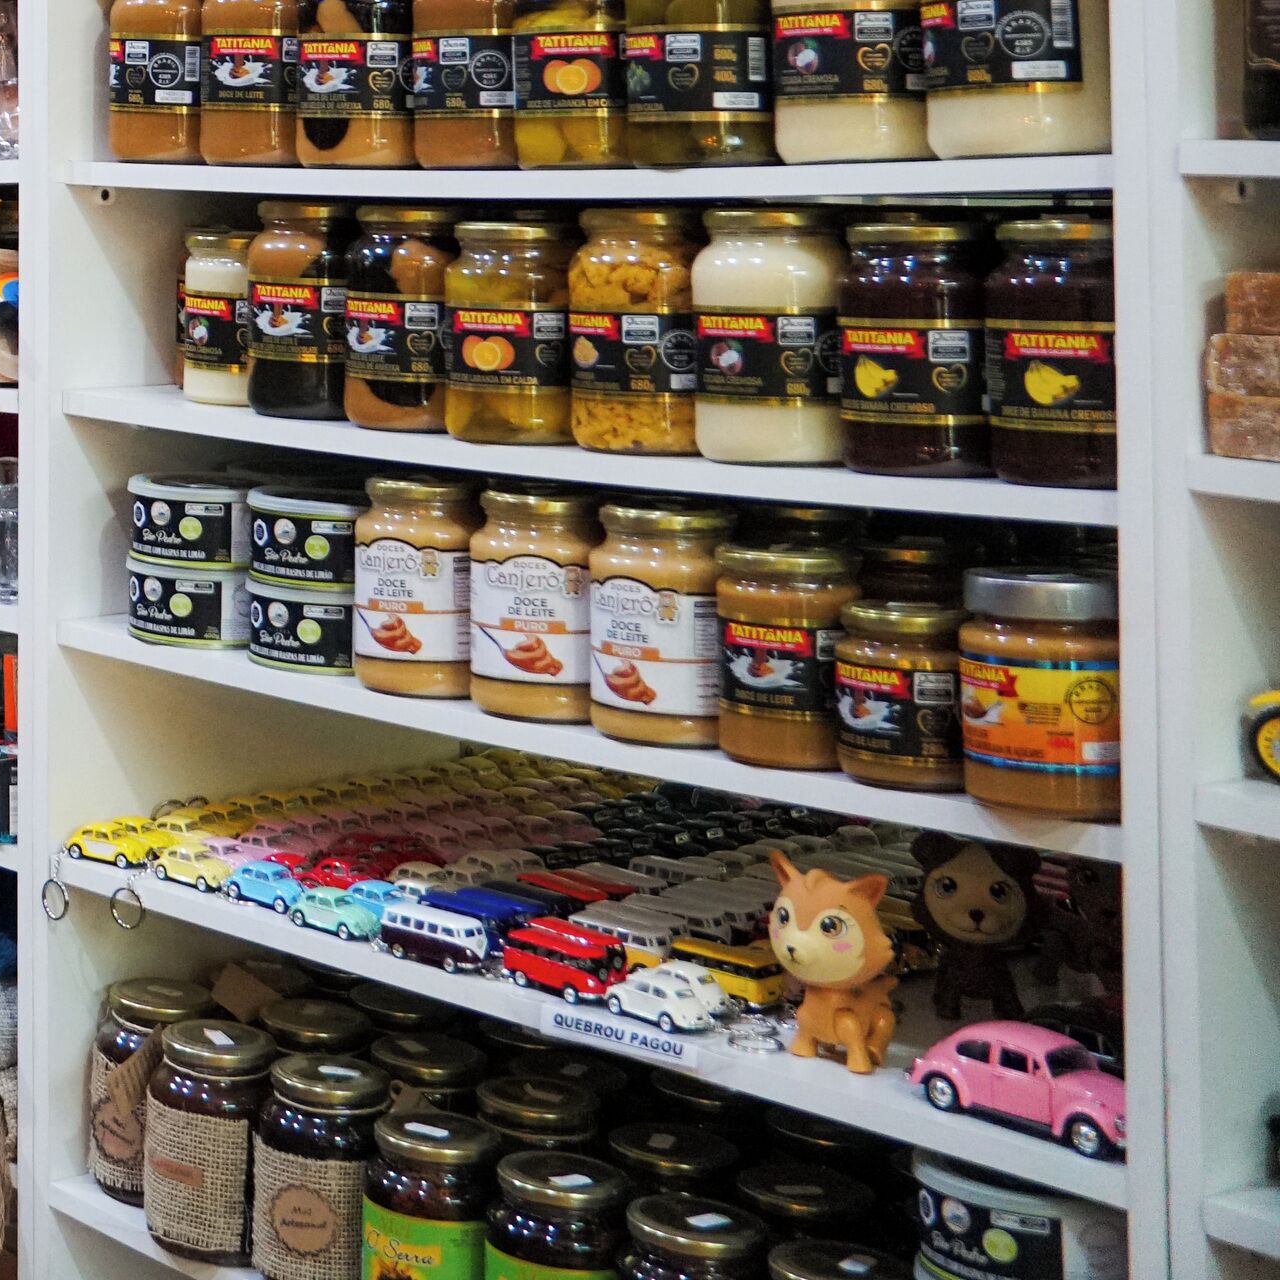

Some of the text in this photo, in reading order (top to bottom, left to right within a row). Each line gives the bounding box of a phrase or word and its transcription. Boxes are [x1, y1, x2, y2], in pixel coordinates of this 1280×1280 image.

[376, 544, 406, 553] DOCES
[513, 560, 547, 570] DOCES
[315, 569, 333, 580] LIMÃO
[488, 566, 559, 591] Canjerô
[377, 578, 406, 588] DOCE
[611, 582, 641, 593] DOCES
[373, 588, 414, 598] DE LEITE
[379, 601, 407, 612] PURO
[514, 596, 548, 607] DOCE
[508, 606, 555, 617] DE LEITE
[515, 621, 548, 632] PURO
[611, 620, 641, 631] DOCE
[607, 629, 648, 643] DE LEITE
[612, 645, 640, 657] PURO
[553, 1012, 686, 1058] QUEBROU PAGOU
[382, 1241, 435, 1266] Serra
